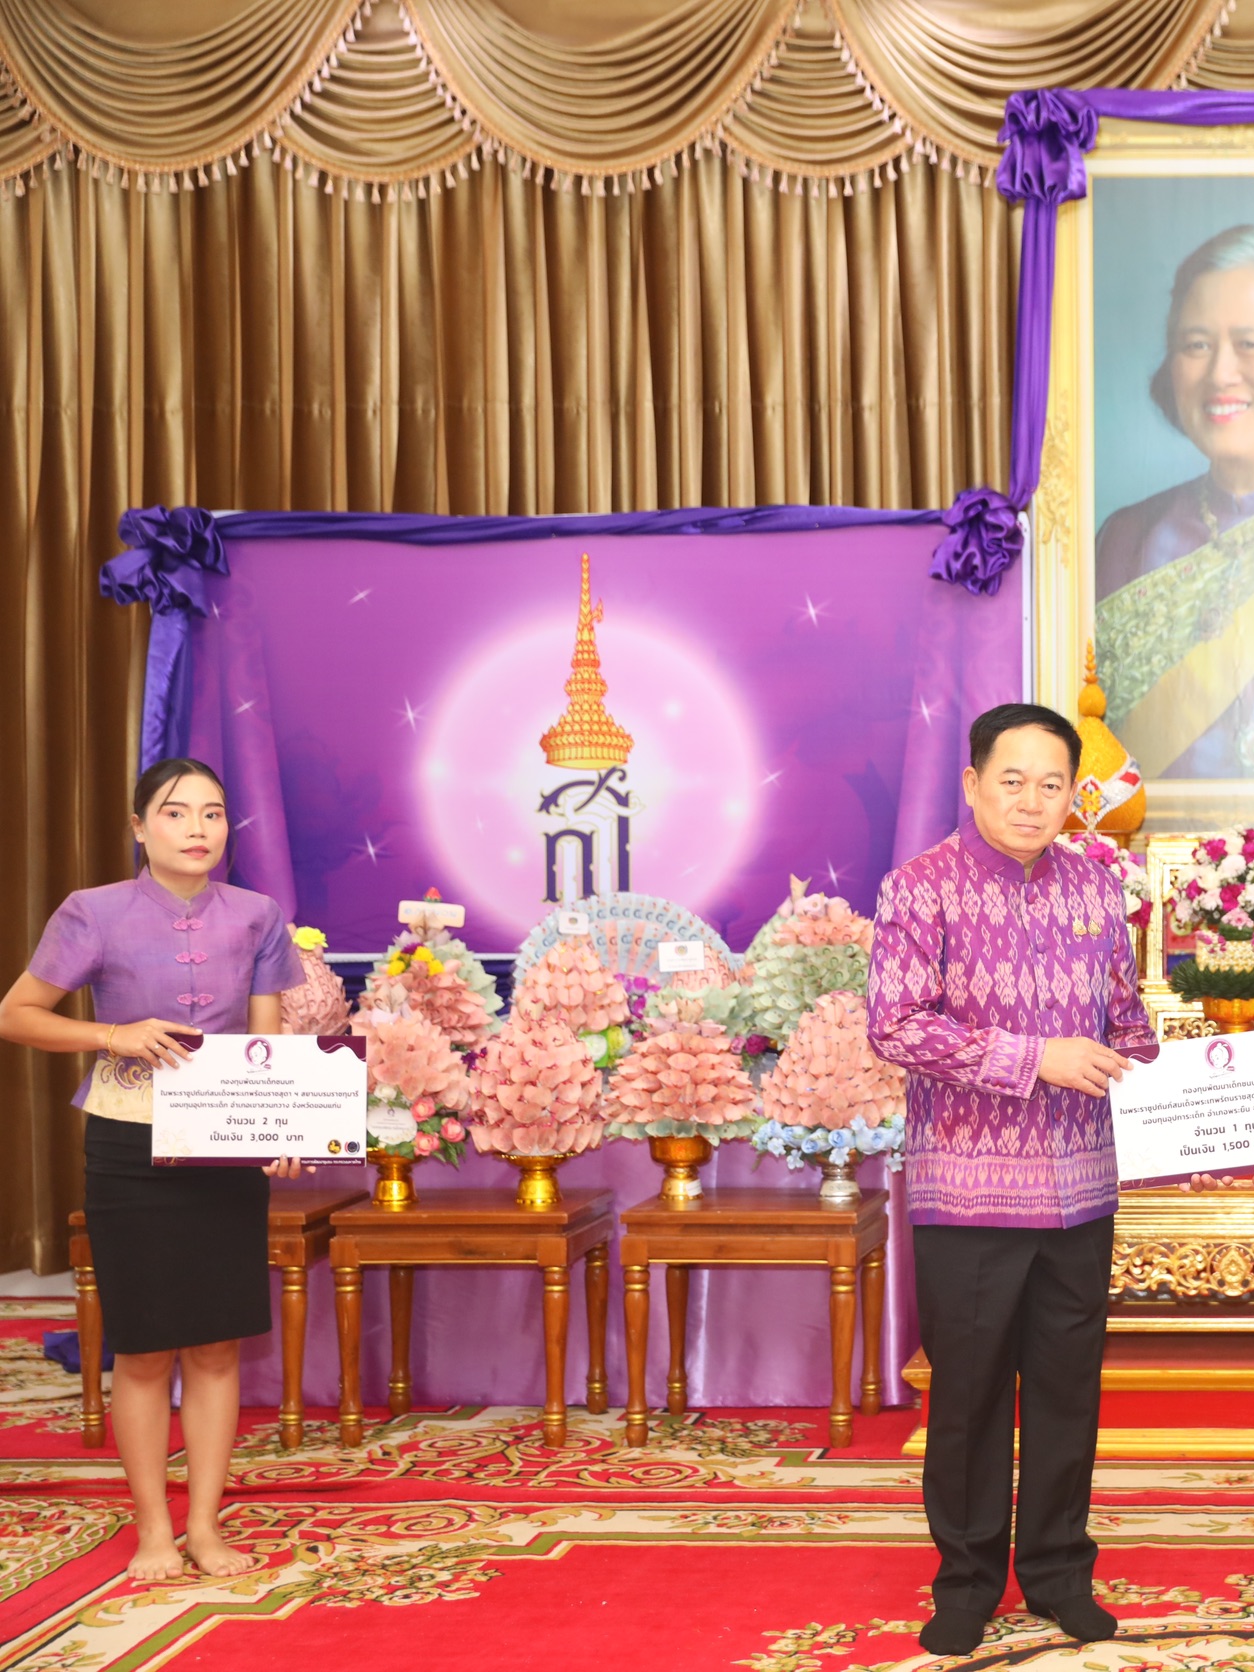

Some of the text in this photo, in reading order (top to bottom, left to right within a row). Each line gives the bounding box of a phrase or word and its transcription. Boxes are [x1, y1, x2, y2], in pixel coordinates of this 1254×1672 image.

[220, 1078, 295, 1087] กองทุนพัฒนาเด็กชนบท
[292, 1101, 342, 1109] จังหวัดขอนแก่น
[226, 1116, 288, 1128] จำนวน 2 ทุน
[1142, 1110, 1205, 1126] มอบทุนอุปการะเด็ก
[1207, 1105, 1251, 1119] อำเภอพระยืน
[209, 1130, 304, 1143] เป็นเงิน 3,000 บาท
[1194, 1123, 1226, 1138] จำนวน
[1232, 1123, 1238, 1132] 1
[1179, 1142, 1216, 1157] เป็นเงิน
[1222, 1140, 1251, 1153] 1,500
